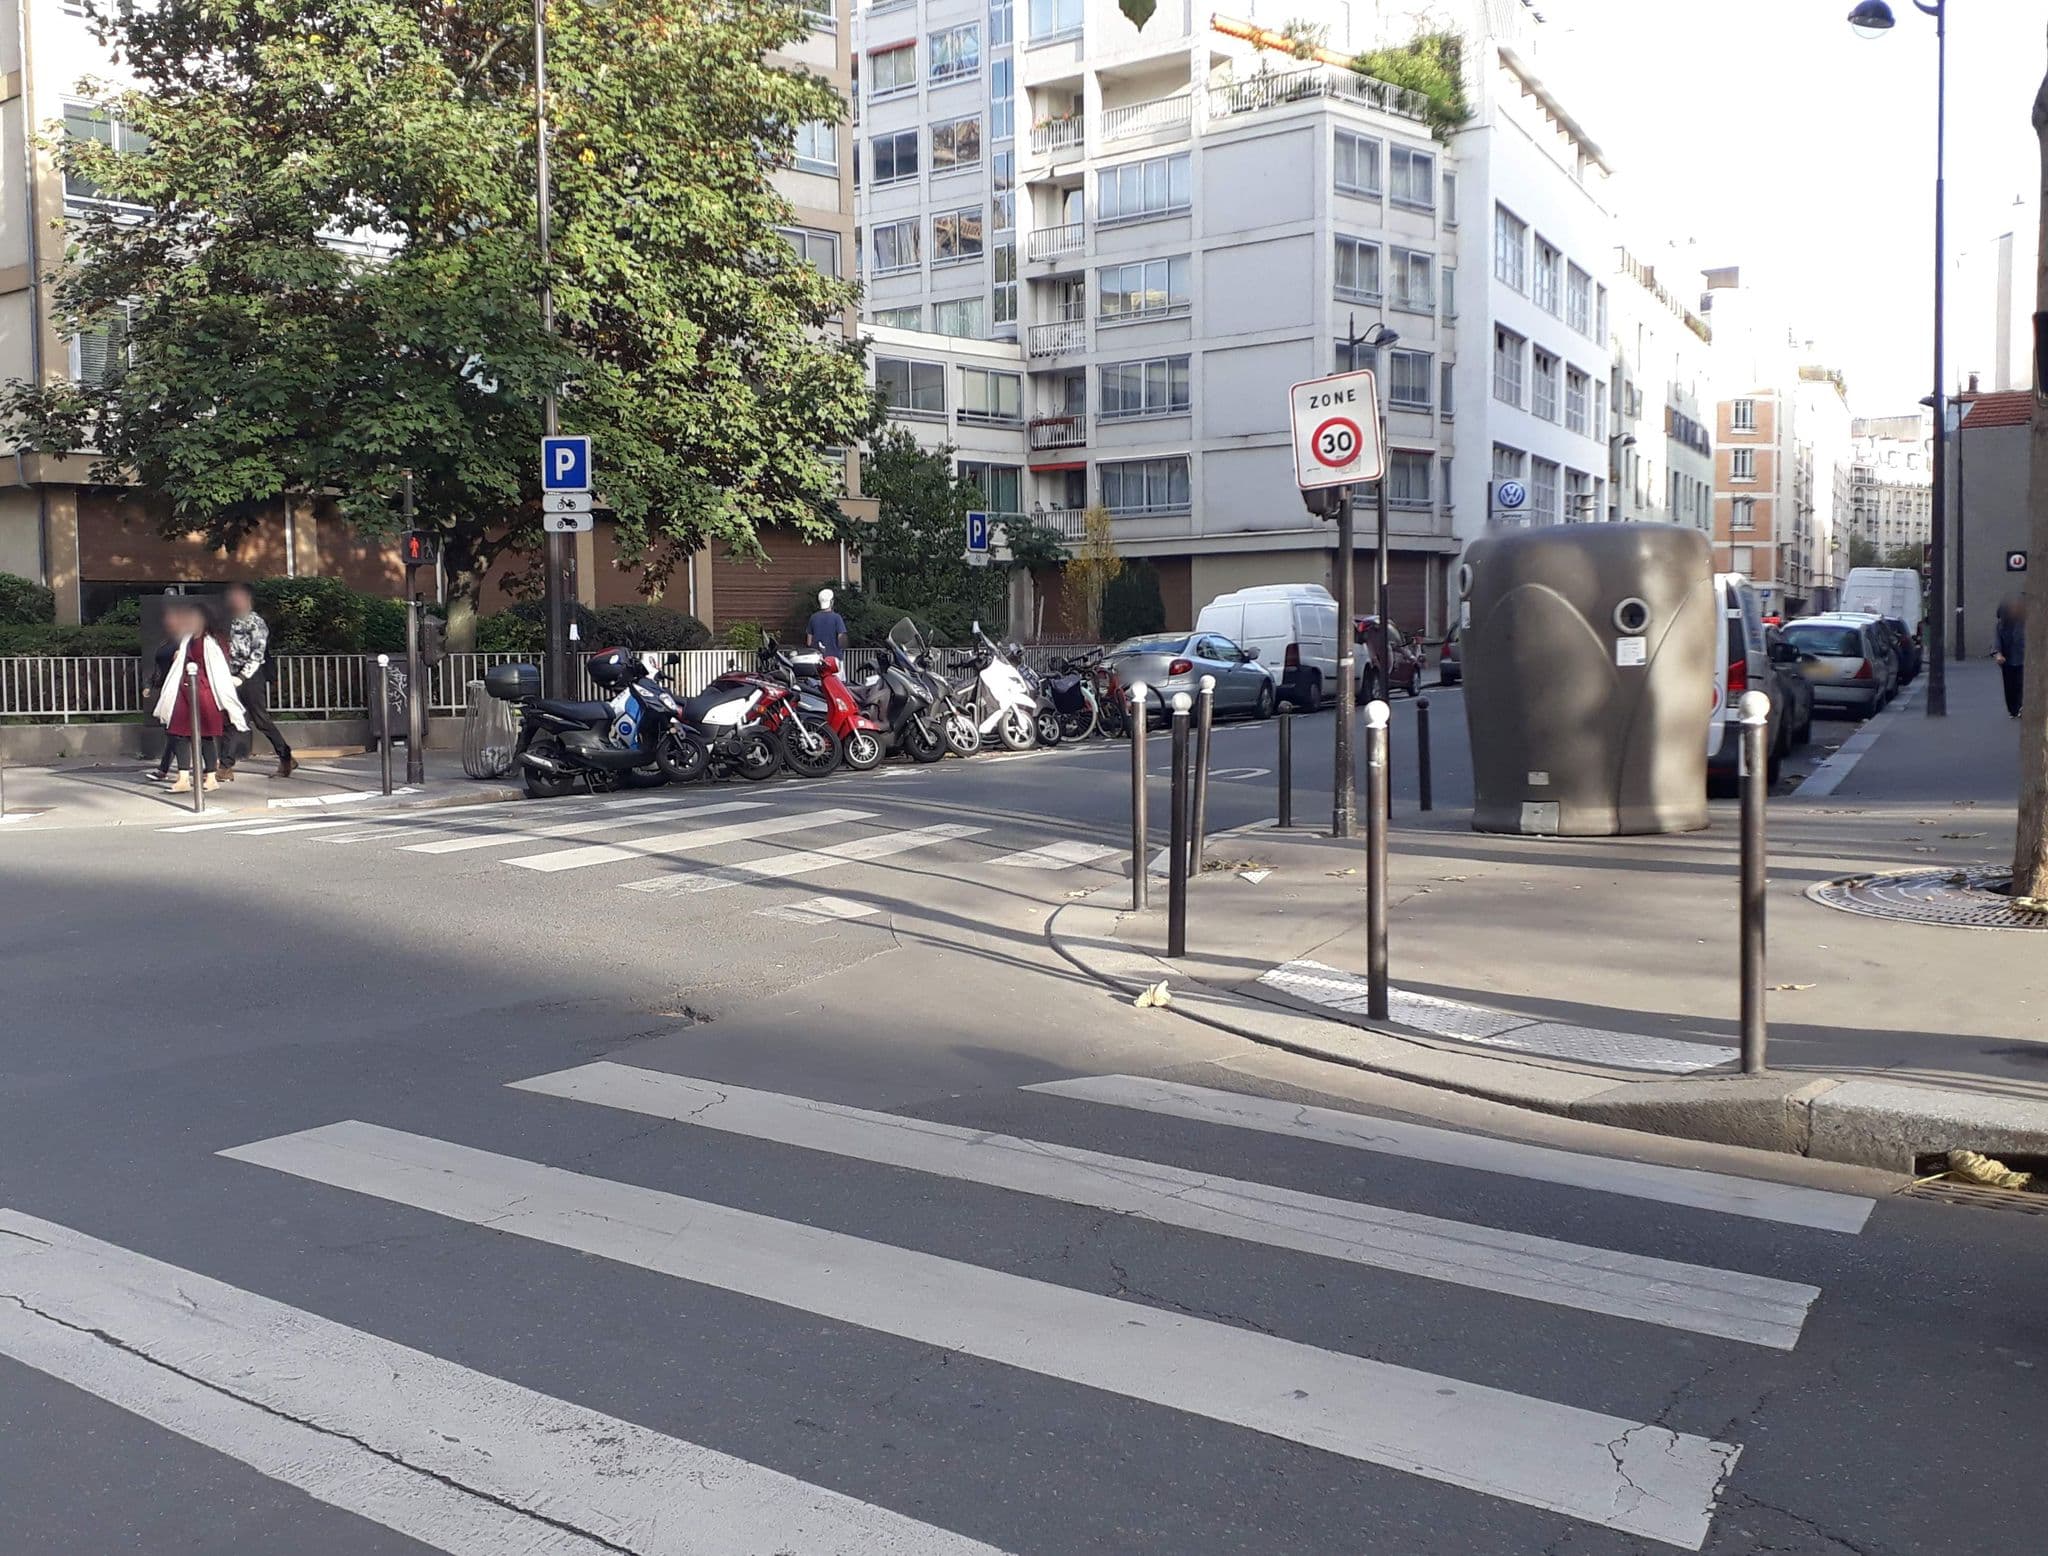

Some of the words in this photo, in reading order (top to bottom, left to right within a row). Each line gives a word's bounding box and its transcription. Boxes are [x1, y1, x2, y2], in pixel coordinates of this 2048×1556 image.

[1310, 389, 1356, 409] ZONE
[1322, 431, 1352, 454] 30
[555, 447, 576, 481] P
[973, 519, 982, 543] P
